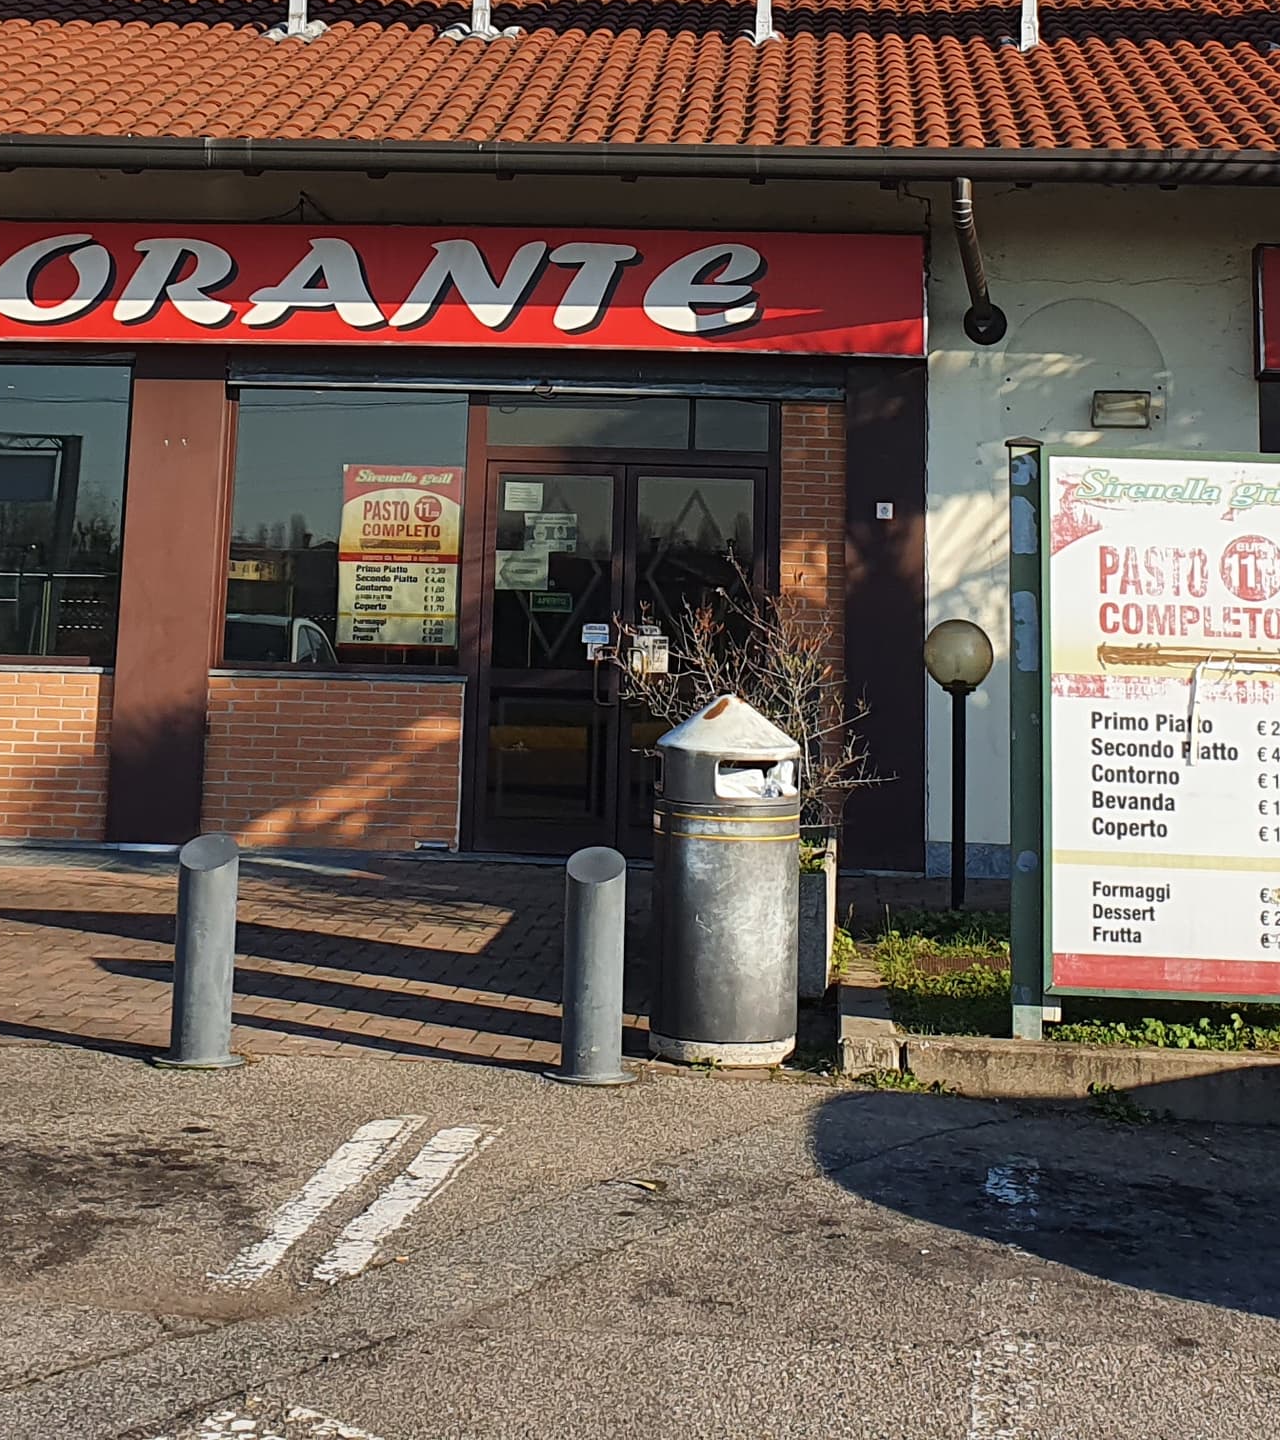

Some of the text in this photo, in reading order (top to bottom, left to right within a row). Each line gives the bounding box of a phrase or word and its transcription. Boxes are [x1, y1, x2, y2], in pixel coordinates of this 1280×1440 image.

[1077, 468, 1220, 503] Sirenella
[363, 500, 410, 521] PASTO
[362, 523, 441, 538] COMPLETO
[356, 574, 391, 583] Secondo
[1099, 545, 1208, 598] PASTO
[355, 583, 393, 592] Contorno
[354, 602, 387, 611] Coperto
[1091, 711, 1149, 732] Primo
[1257, 720, 1267, 736] €
[1091, 737, 1174, 759] Secondo
[1257, 746, 1267, 762] €
[1091, 764, 1180, 785] Contorno
[1258, 773, 1268, 789] €
[1092, 790, 1176, 812] Bevanda
[1258, 799, 1268, 815] €
[1092, 817, 1168, 841] Coperto
[1259, 826, 1269, 842] €
[1092, 881, 1171, 903] Formaggi
[1092, 904, 1156, 922] Dessert
[1260, 910, 1270, 926] €
[1092, 926, 1143, 944] Frutta
